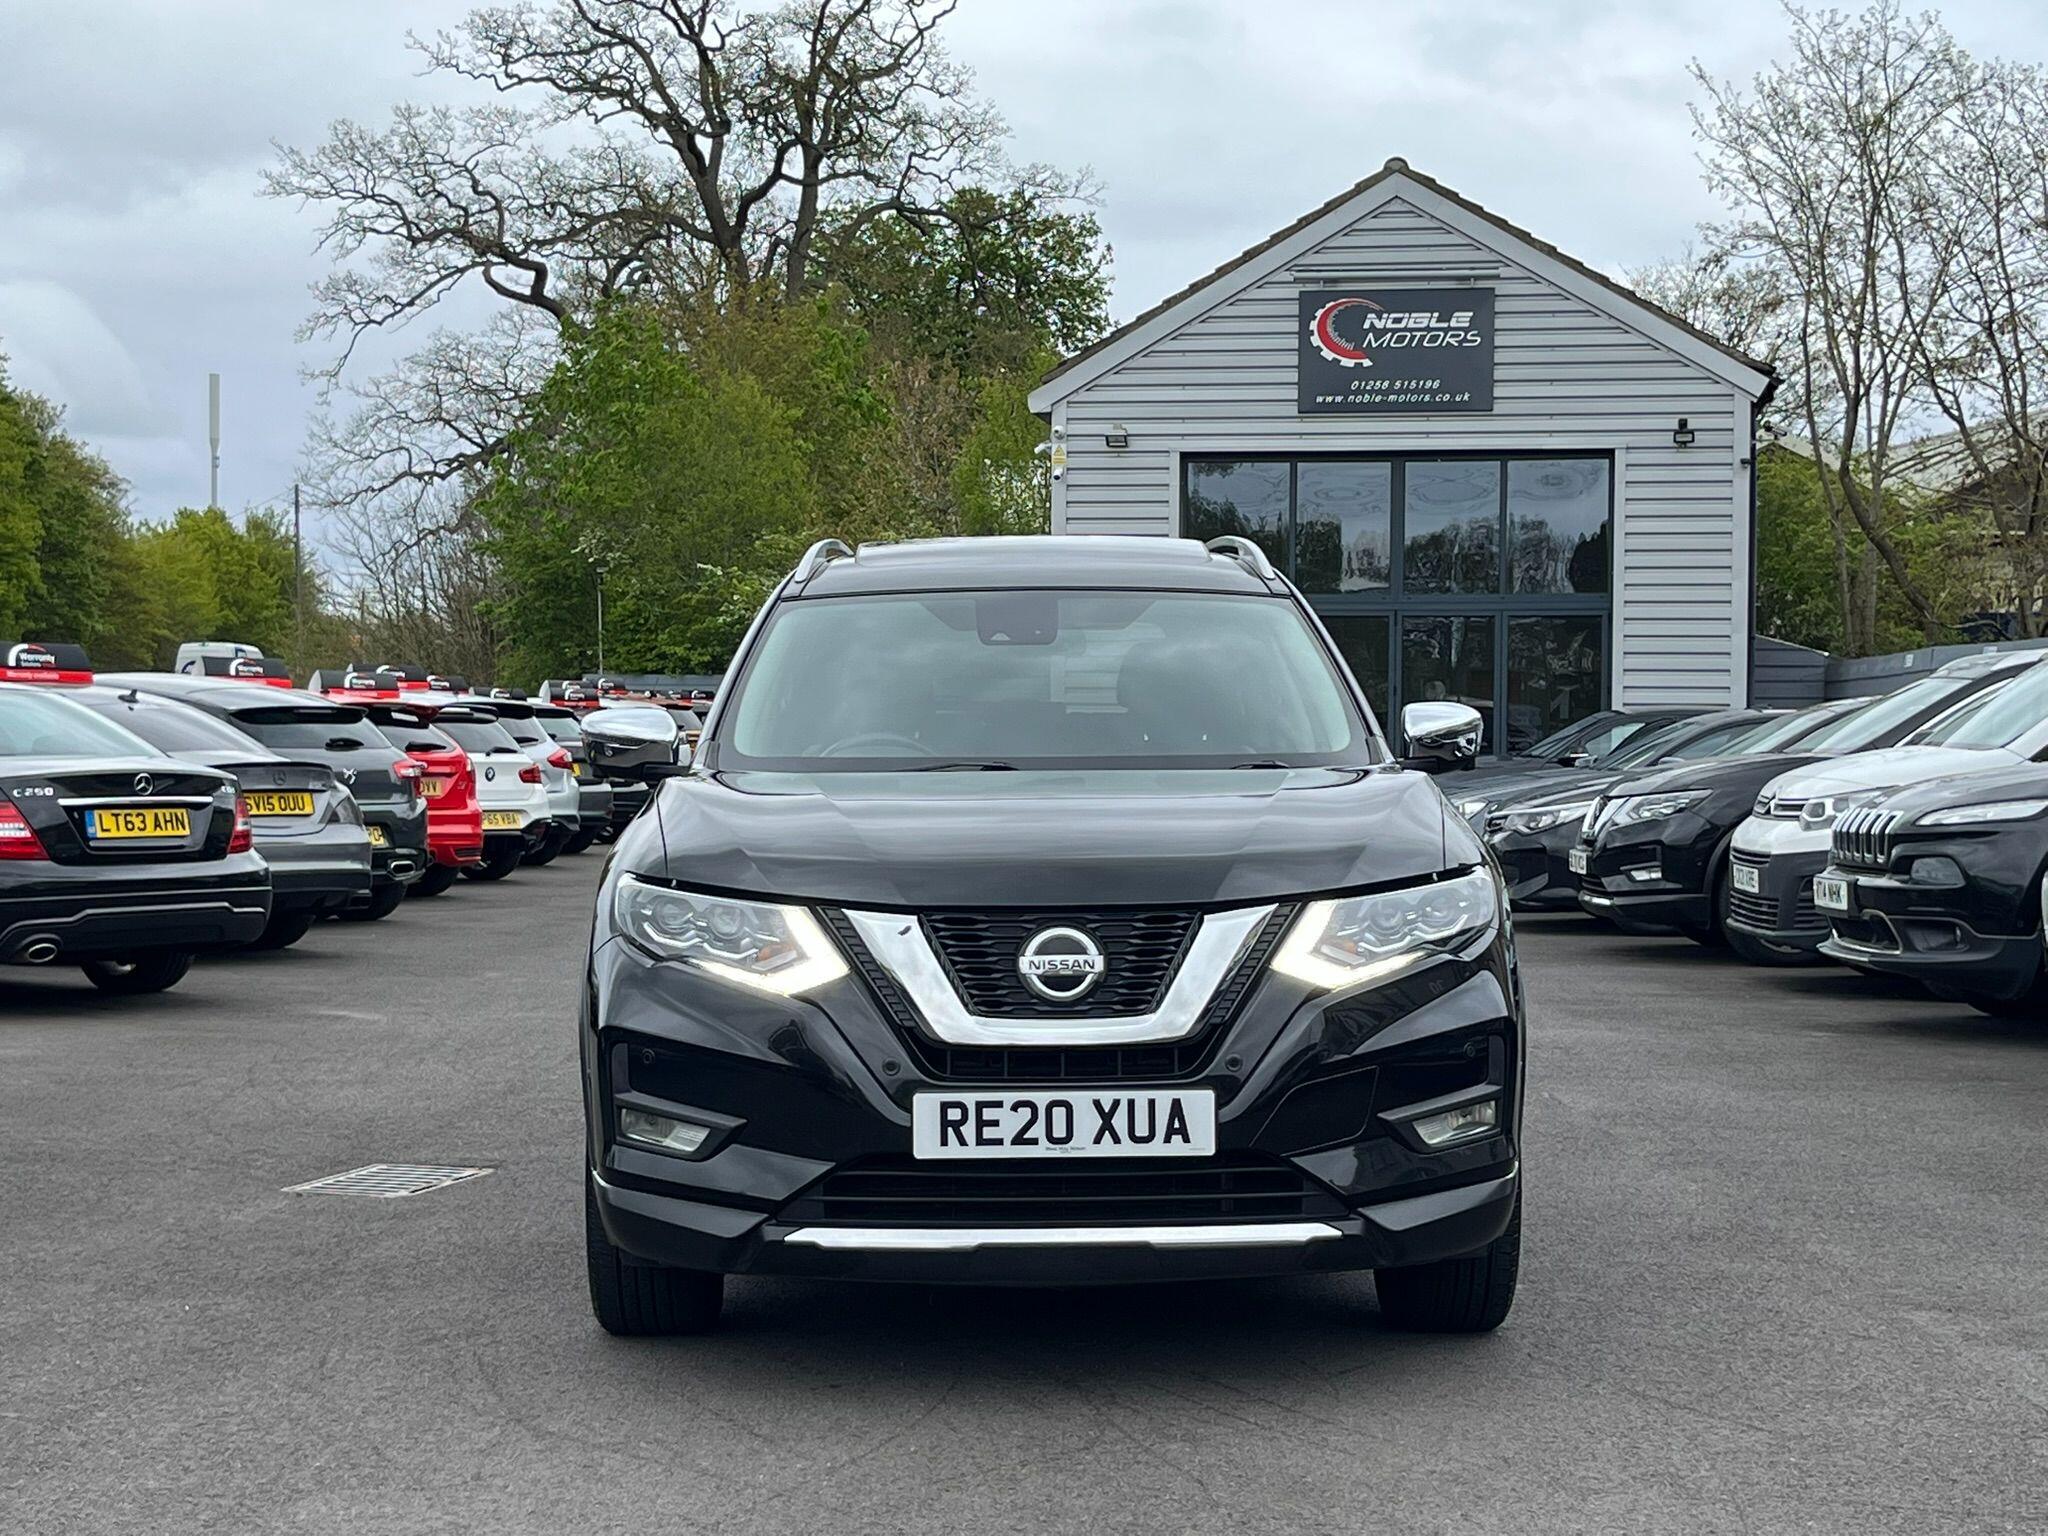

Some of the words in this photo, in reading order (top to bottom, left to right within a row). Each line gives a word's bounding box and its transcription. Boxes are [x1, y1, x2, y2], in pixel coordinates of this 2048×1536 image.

[1362, 311, 1474, 329] NOBLE
[1362, 330, 1482, 348] MOTORS
[1315, 391, 1471, 404] www.noble-motors.co.uk
[278, 795, 305, 812] OUU
[98, 811, 147, 835] LT63
[152, 809, 188, 832] AHN
[1028, 958, 1096, 972] NISSAN
[939, 1099, 1074, 1148] RE20
[1092, 1098, 1191, 1145] XUA
